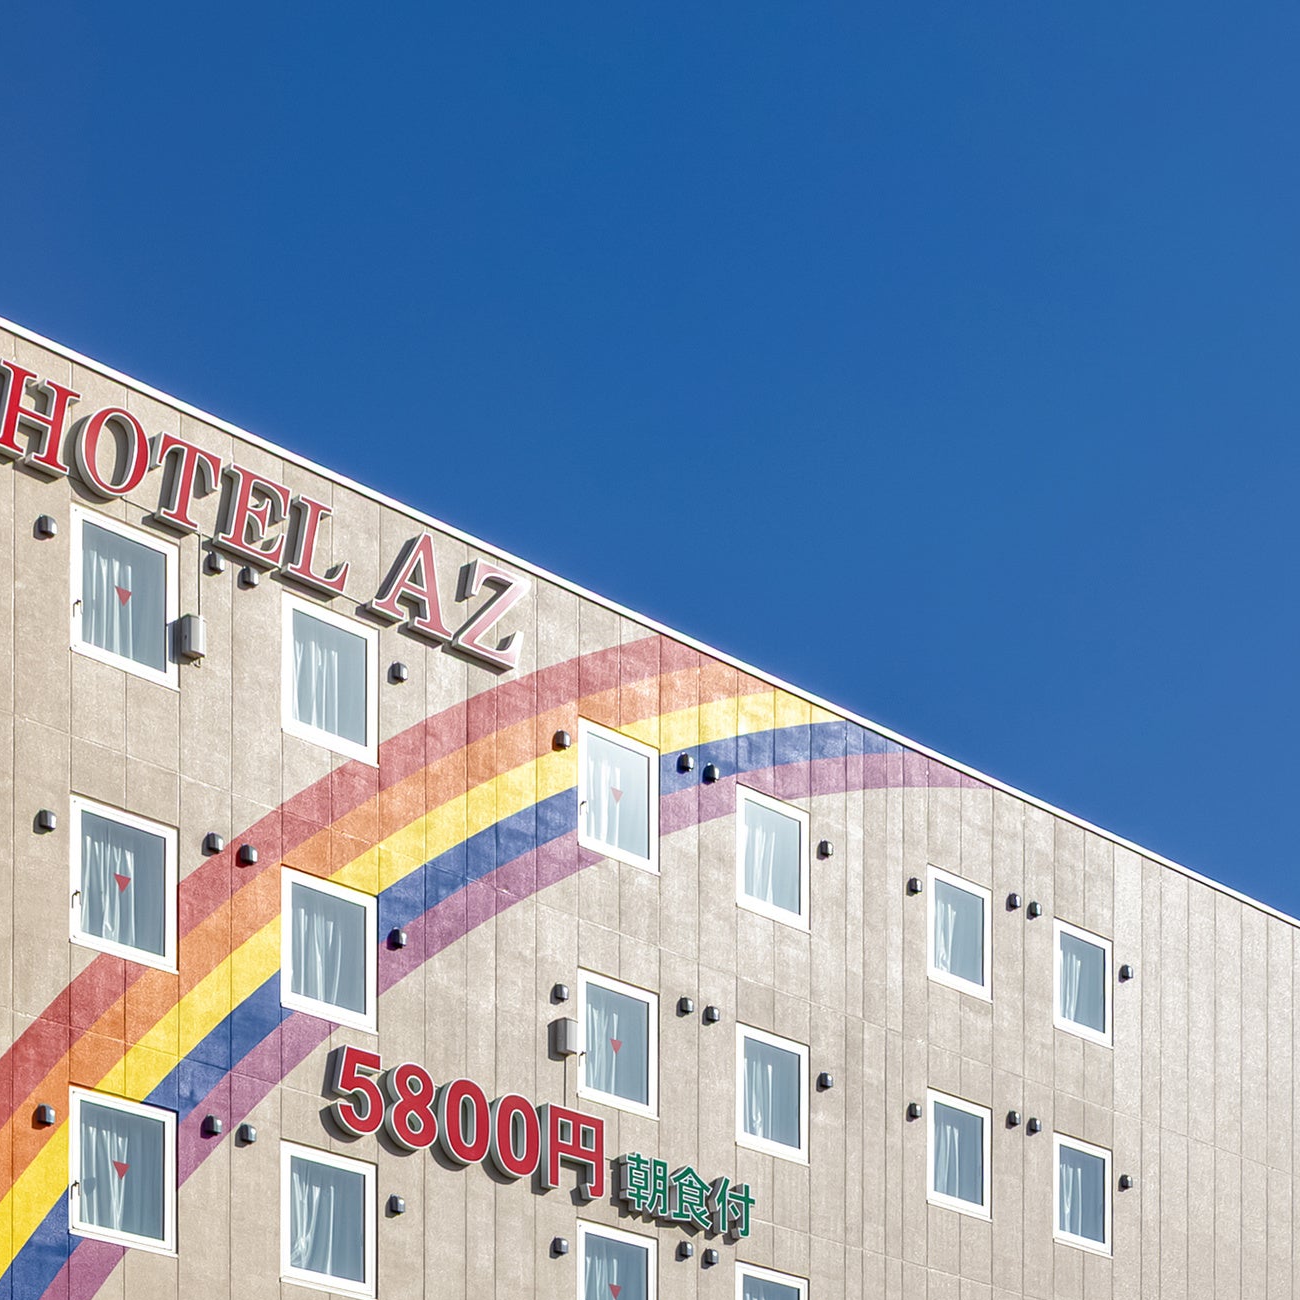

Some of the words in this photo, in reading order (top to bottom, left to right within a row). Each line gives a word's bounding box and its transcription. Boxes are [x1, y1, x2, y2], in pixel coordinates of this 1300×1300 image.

[370, 530, 532, 670] AZ
[334, 1045, 606, 1200] 5800円
[624, 1151, 756, 1239] 朝食付
